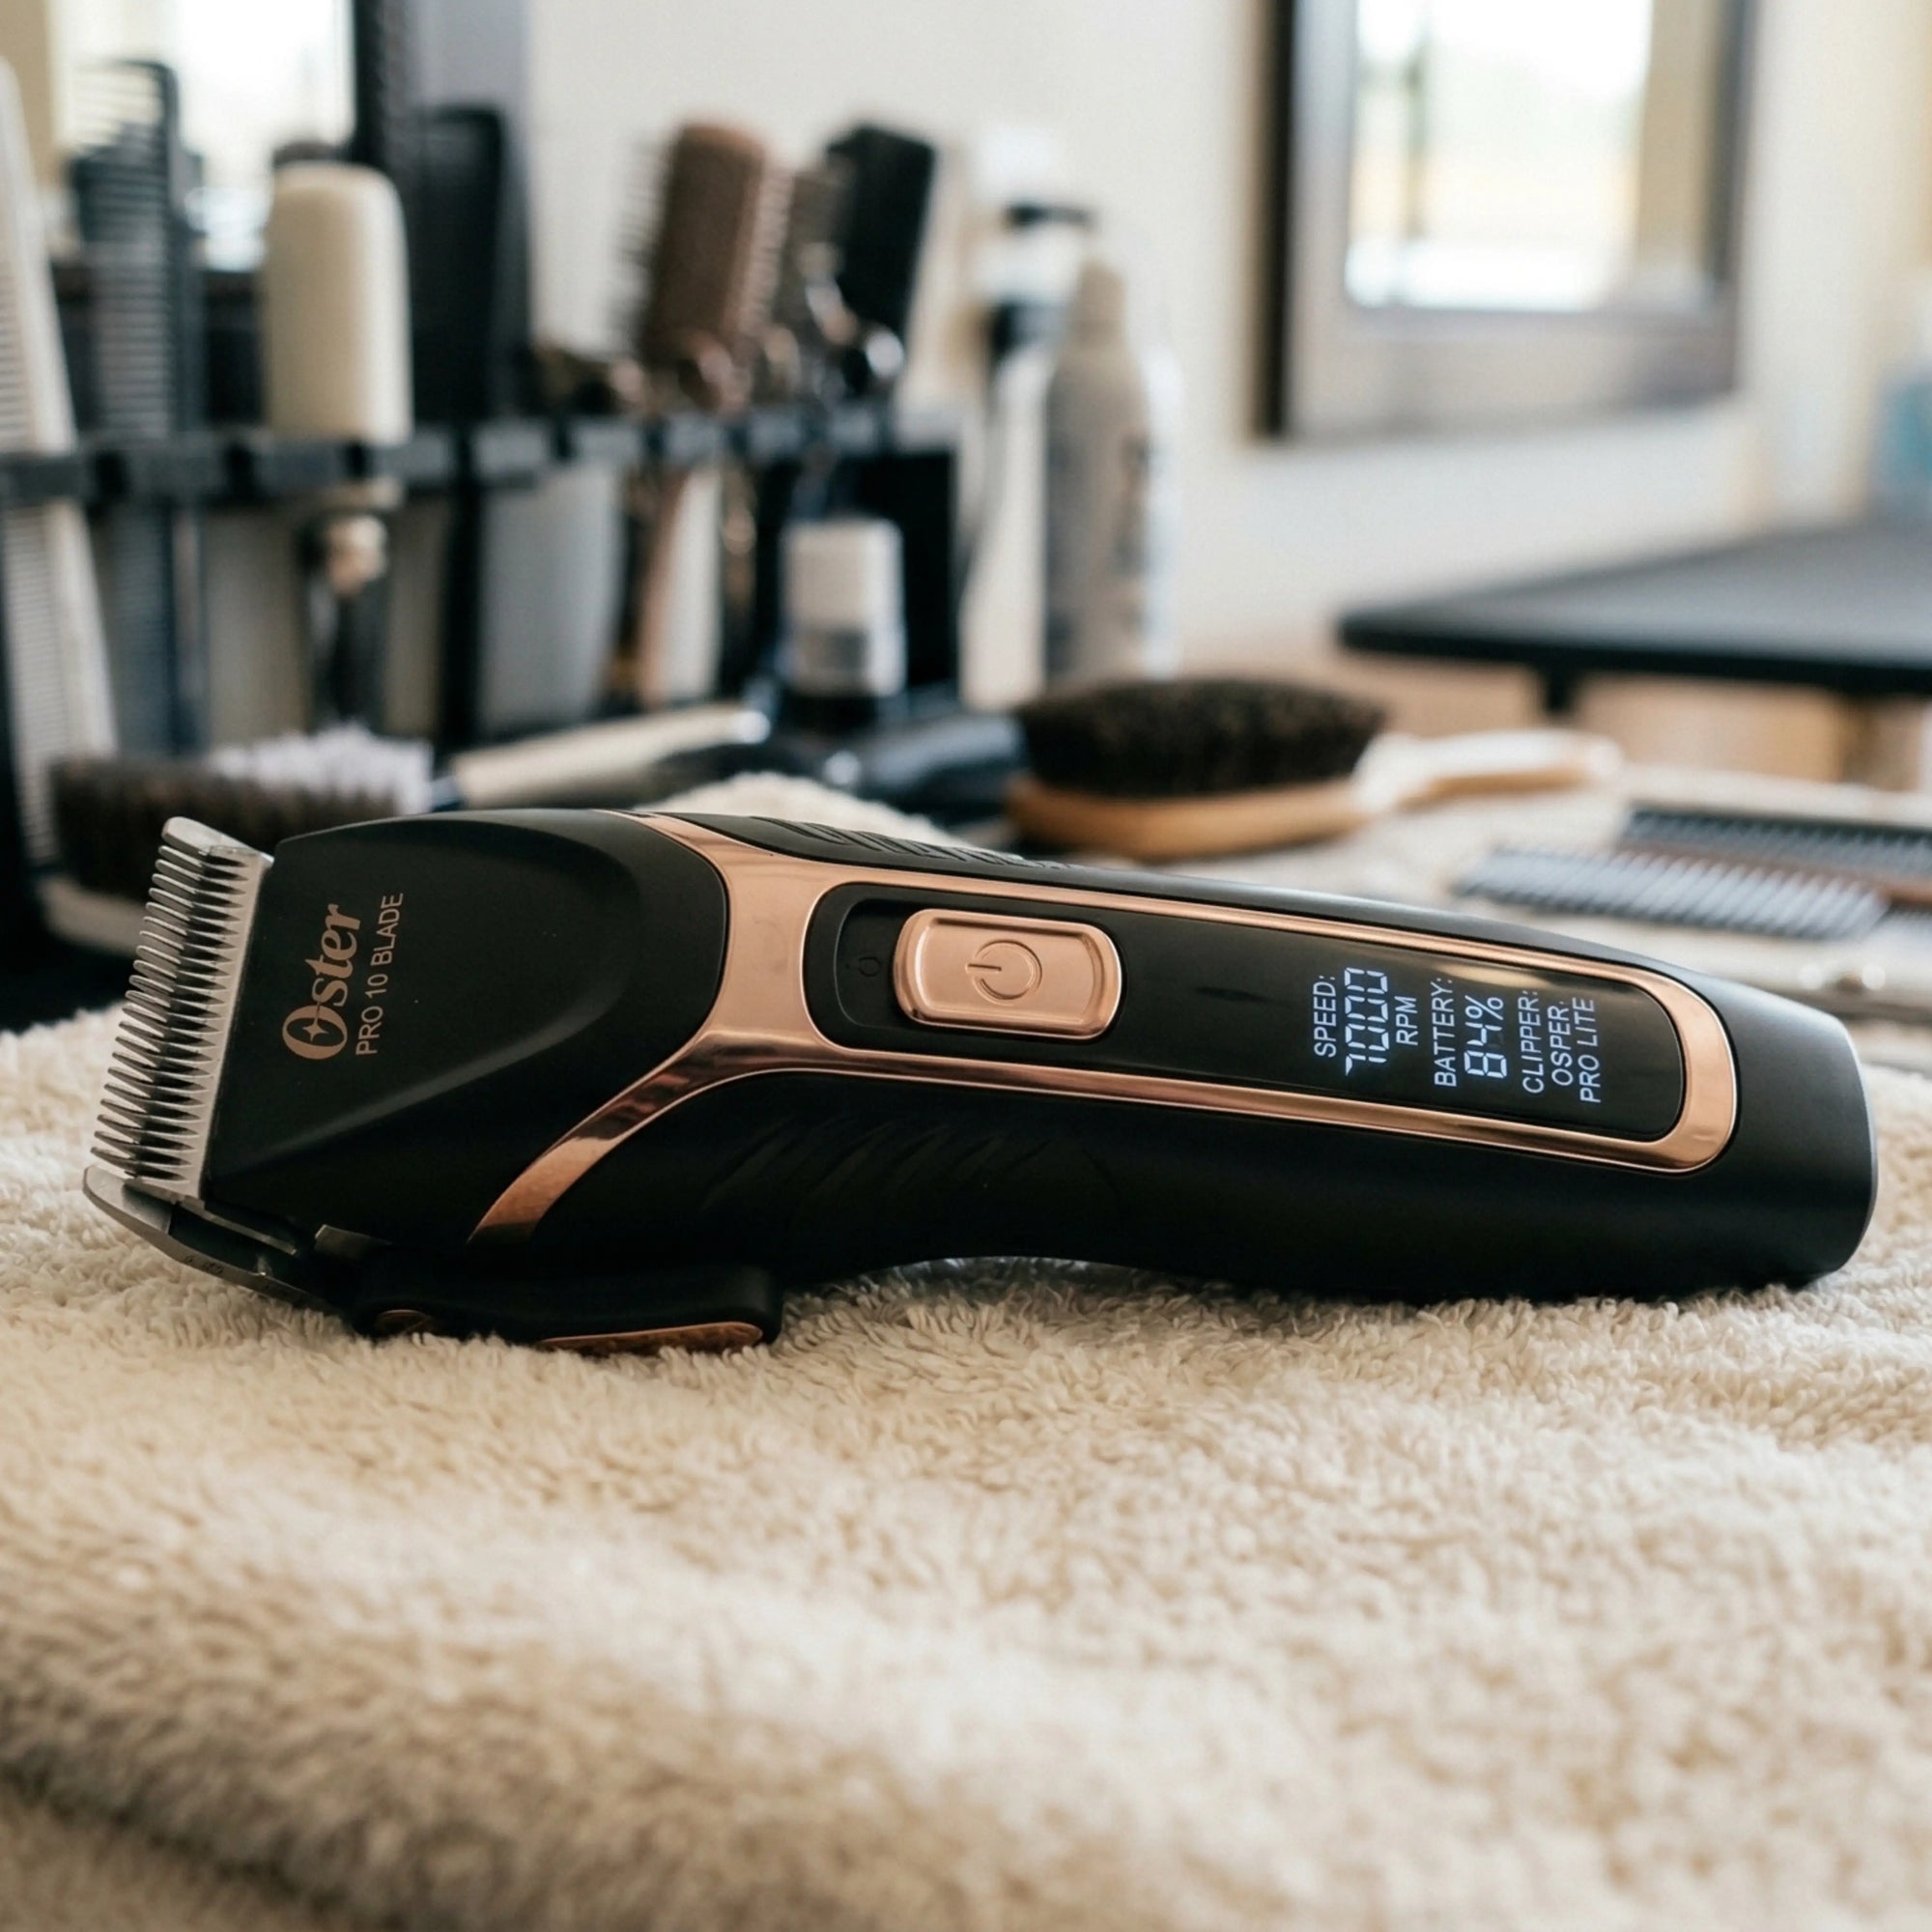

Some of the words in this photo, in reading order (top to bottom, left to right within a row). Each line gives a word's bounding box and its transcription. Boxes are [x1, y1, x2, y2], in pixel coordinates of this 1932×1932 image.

[370, 893, 404, 966] BLADE
[282, 903, 360, 1060] Oster
[365, 973, 388, 999] 10
[1313, 975, 1337, 1058] SPEED:
[355, 1006, 384, 1055] PRO
[1344, 967, 1390, 1076] 7000
[1394, 996, 1419, 1046] RPM
[1431, 978, 1457, 1087] BATTERY:
[1463, 995, 1508, 1079] 84%
[1518, 990, 1545, 1094] CLIPPER:
[1572, 997, 1599, 1047] LITE
[1578, 1054, 1602, 1103] PRO
